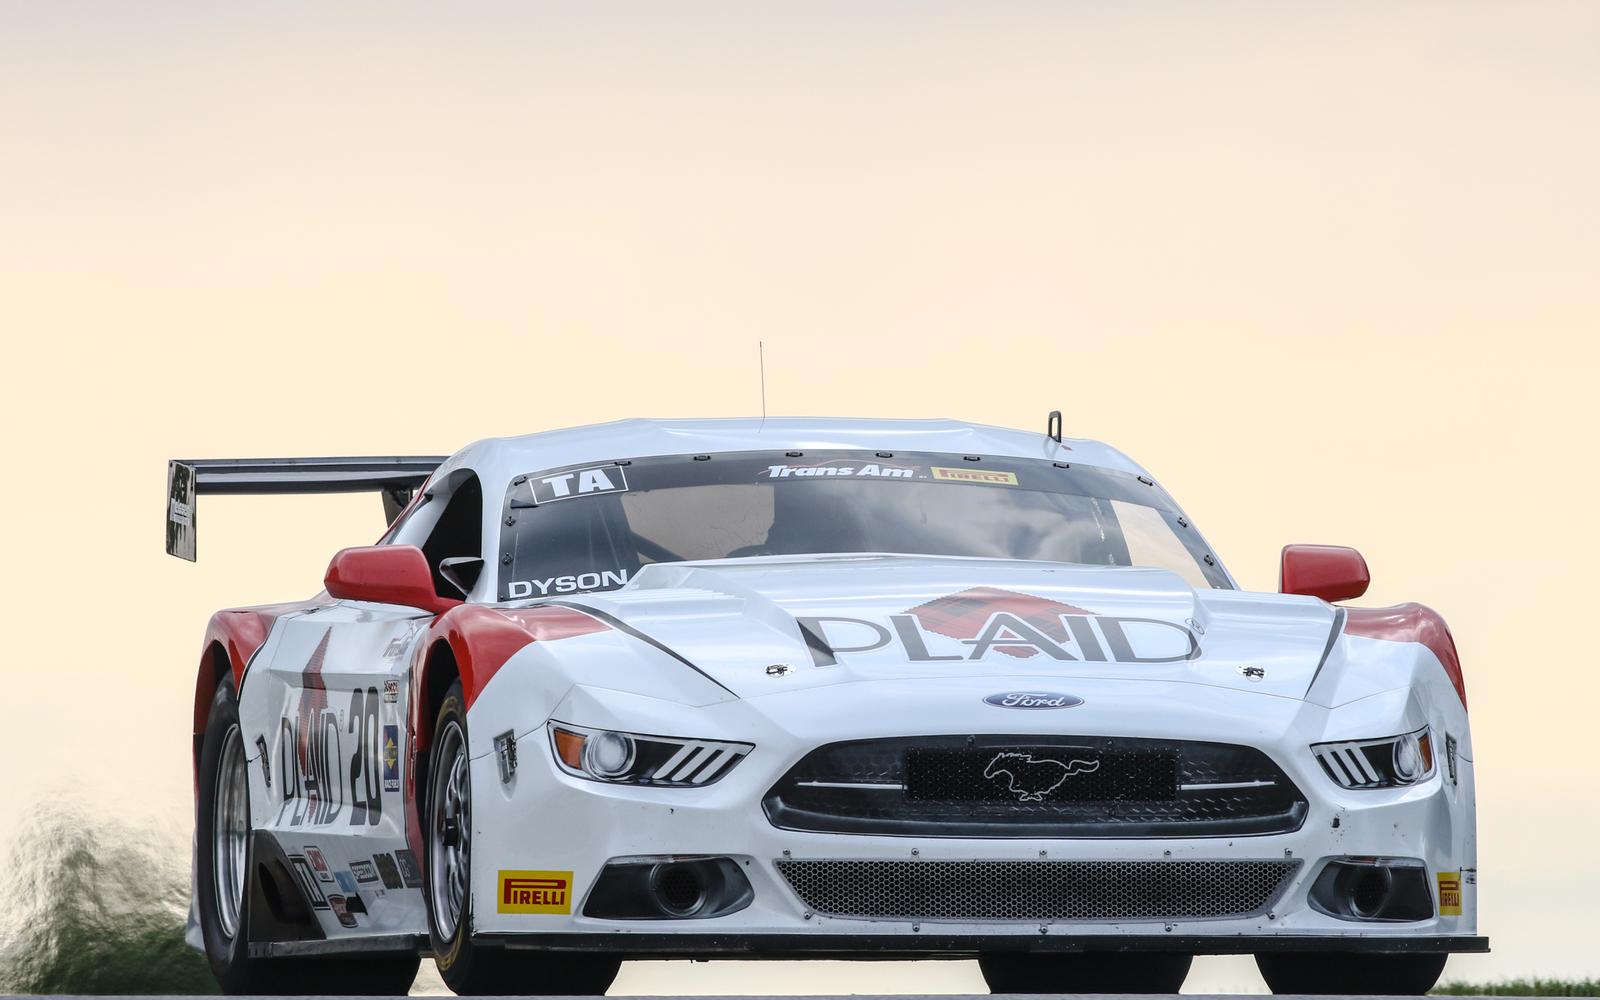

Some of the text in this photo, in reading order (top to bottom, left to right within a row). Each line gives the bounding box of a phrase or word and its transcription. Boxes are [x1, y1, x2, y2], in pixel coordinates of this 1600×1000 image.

[542, 468, 615, 497] TA
[768, 464, 914, 478] Trans Am
[508, 569, 628, 599] DYSON
[797, 612, 1202, 667] PLAID
[1002, 693, 1065, 706] Ford
[275, 707, 342, 827] PLAID
[349, 686, 381, 826] 20
[504, 878, 566, 905] PIRELLI
[1440, 880, 1459, 906] PIRELLI
